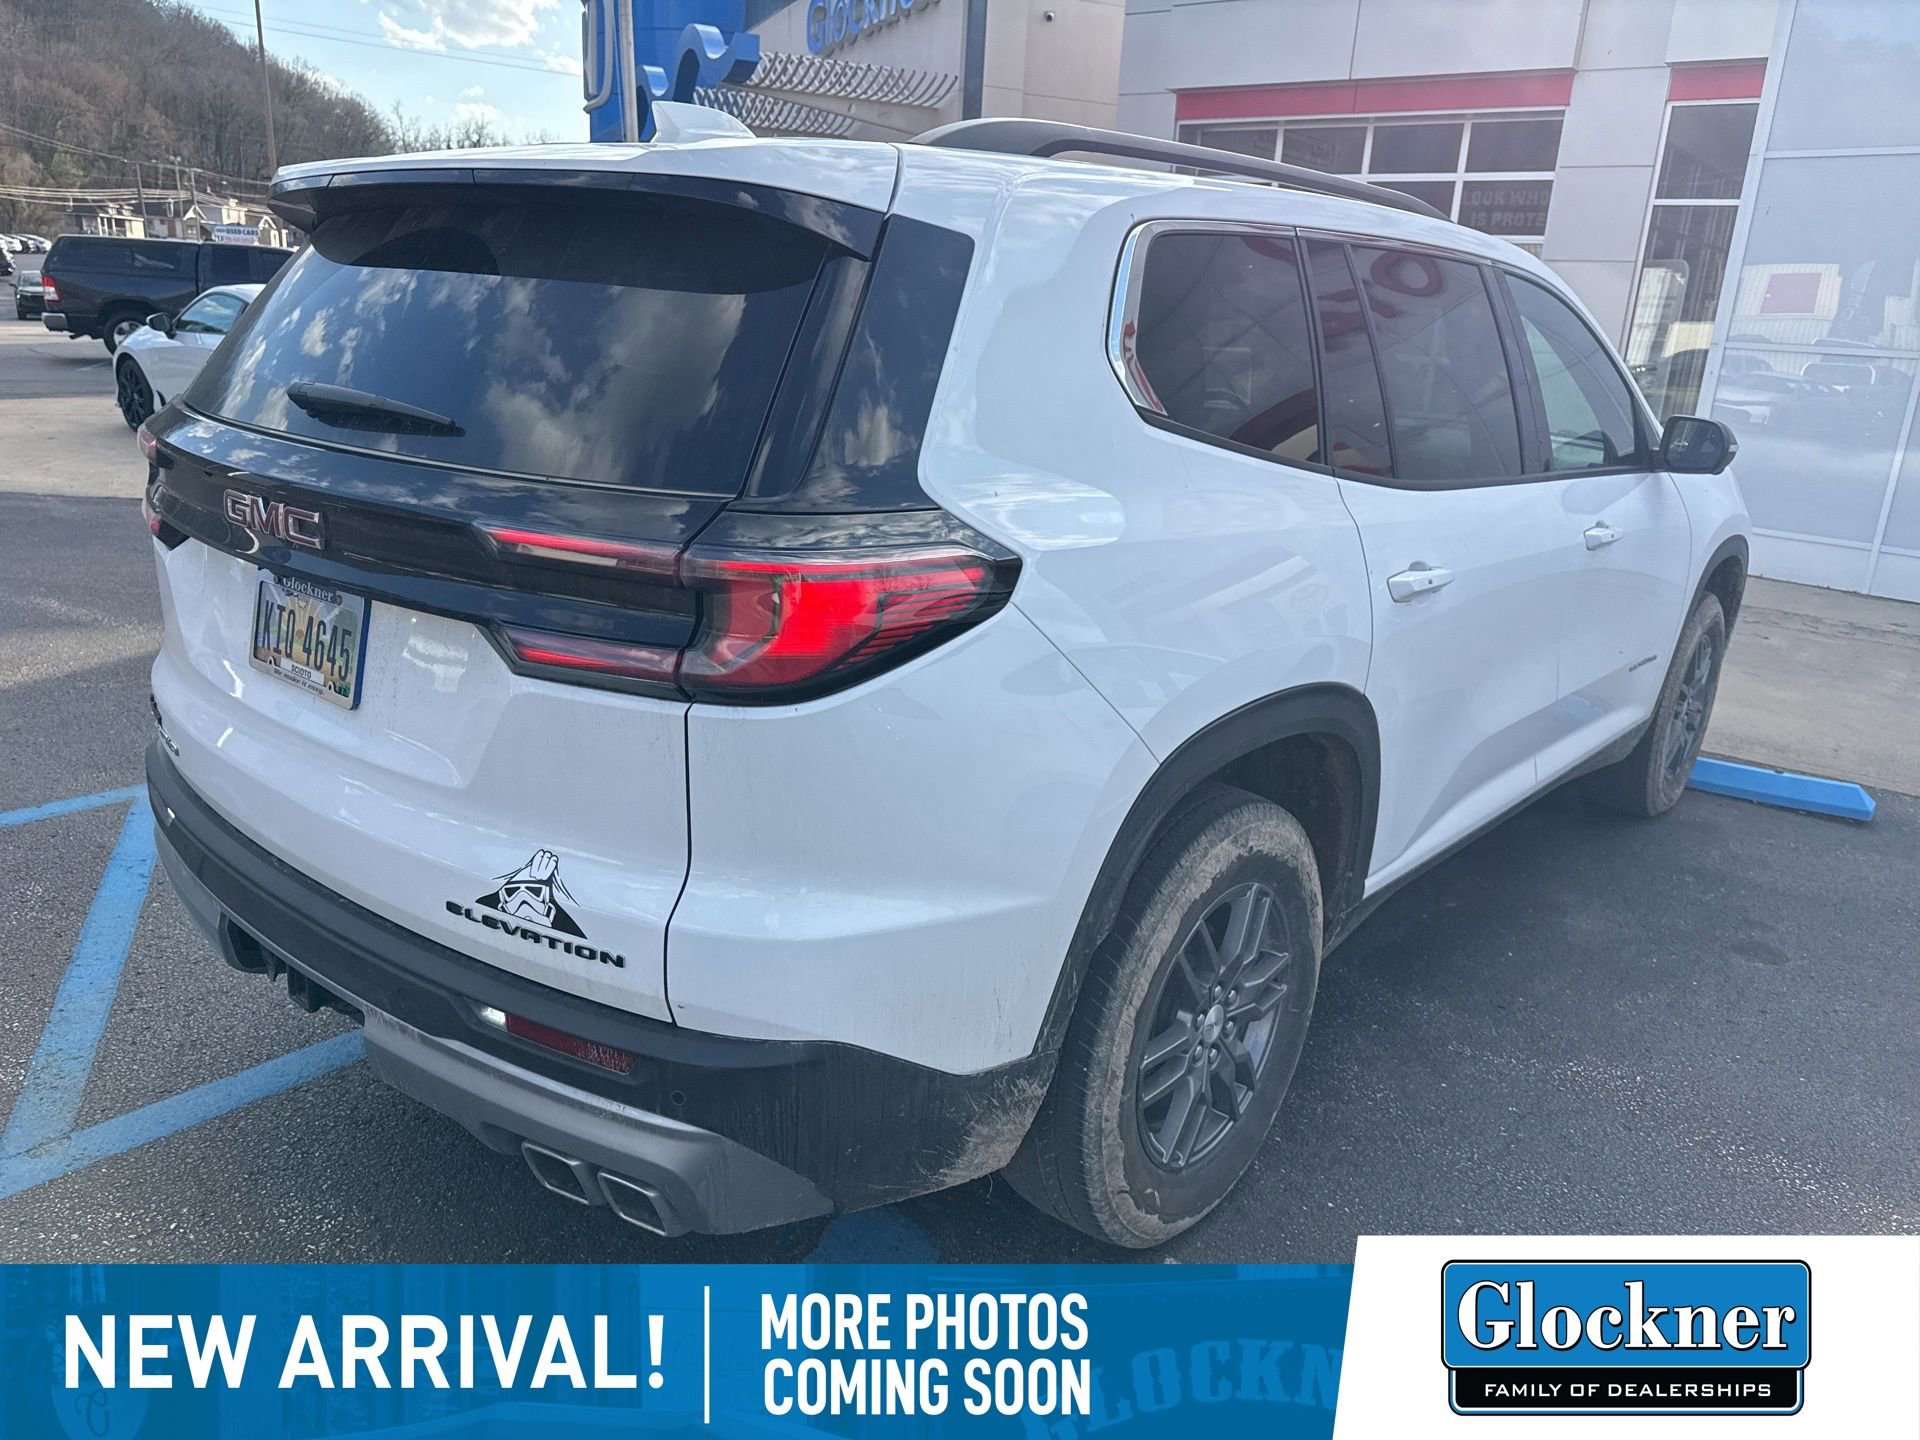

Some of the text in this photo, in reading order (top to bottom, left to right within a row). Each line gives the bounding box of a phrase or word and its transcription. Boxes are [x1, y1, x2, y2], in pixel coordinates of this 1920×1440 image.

[1463, 189, 1550, 206] LOOK WHO
[1471, 211, 1487, 226] IS
[226, 227, 242, 235] USED
[243, 228, 259, 236] CARS
[223, 488, 322, 550] GMC
[283, 576, 334, 602] Glockner
[302, 616, 353, 681] 4645
[283, 672, 300, 684] make
[291, 664, 312, 679] SCIOTO
[445, 900, 626, 969] ELEVATION
